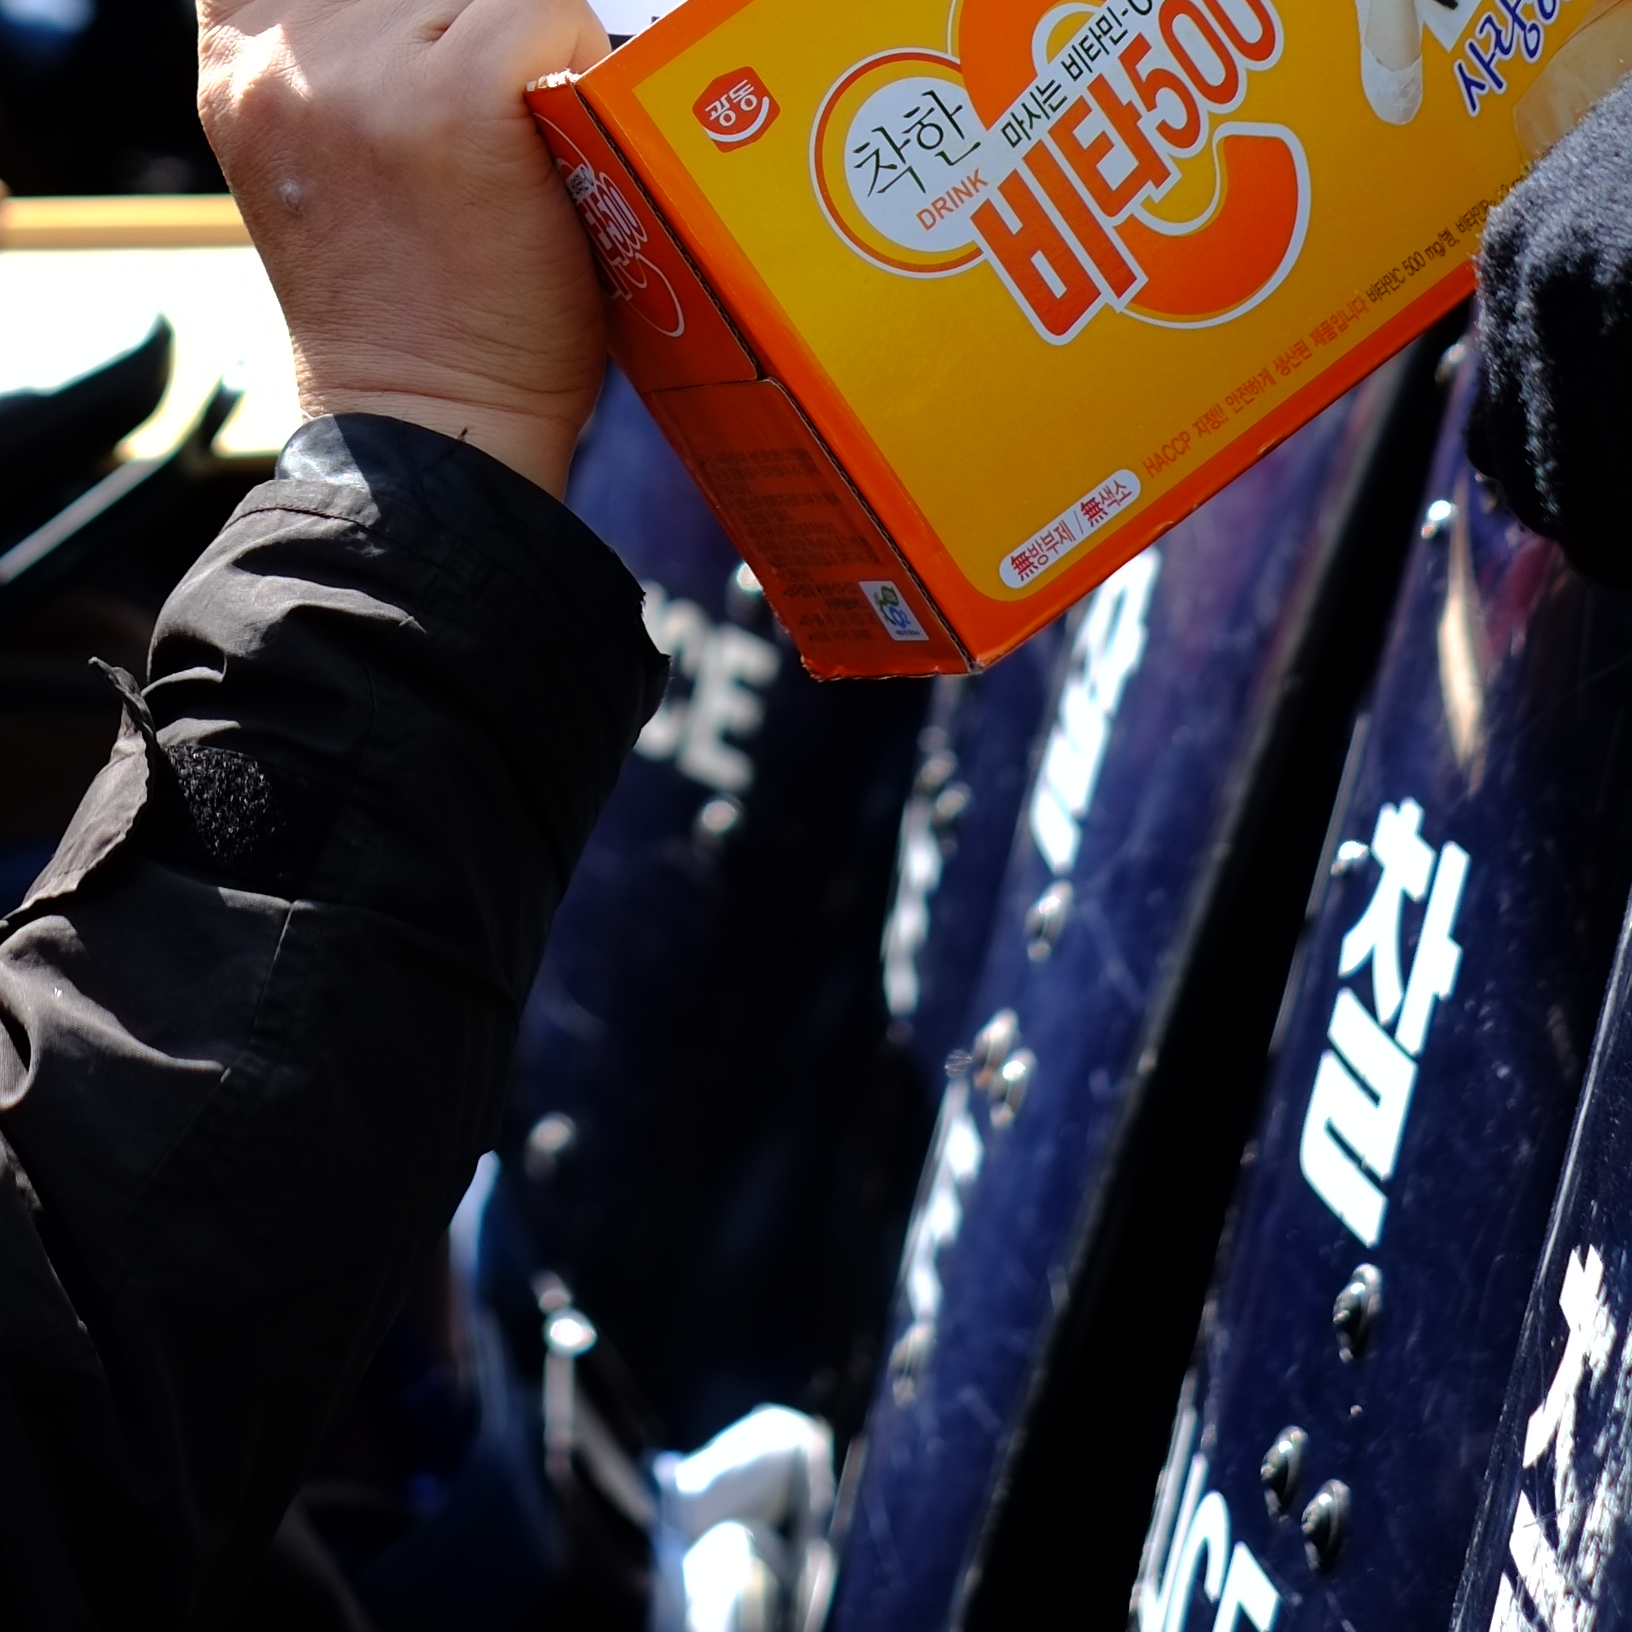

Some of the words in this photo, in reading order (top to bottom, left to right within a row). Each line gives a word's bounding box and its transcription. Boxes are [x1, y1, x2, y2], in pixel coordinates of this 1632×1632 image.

[702, 79, 766, 126] 광동
[1000, 79, 1067, 150] 마시는
[850, 89, 978, 200] 착한
[917, 172, 988, 233] DRINK
[1401, 250, 1427, 278] 500
[1141, 428, 1196, 479] HACCP
[1224, 366, 1279, 416] 안전하게
[1270, 338, 1315, 379] 생산된
[1307, 293, 1371, 352] 제품입니다
[1009, 518, 1077, 581] 無방부제
[1080, 480, 1132, 527] 無색소
